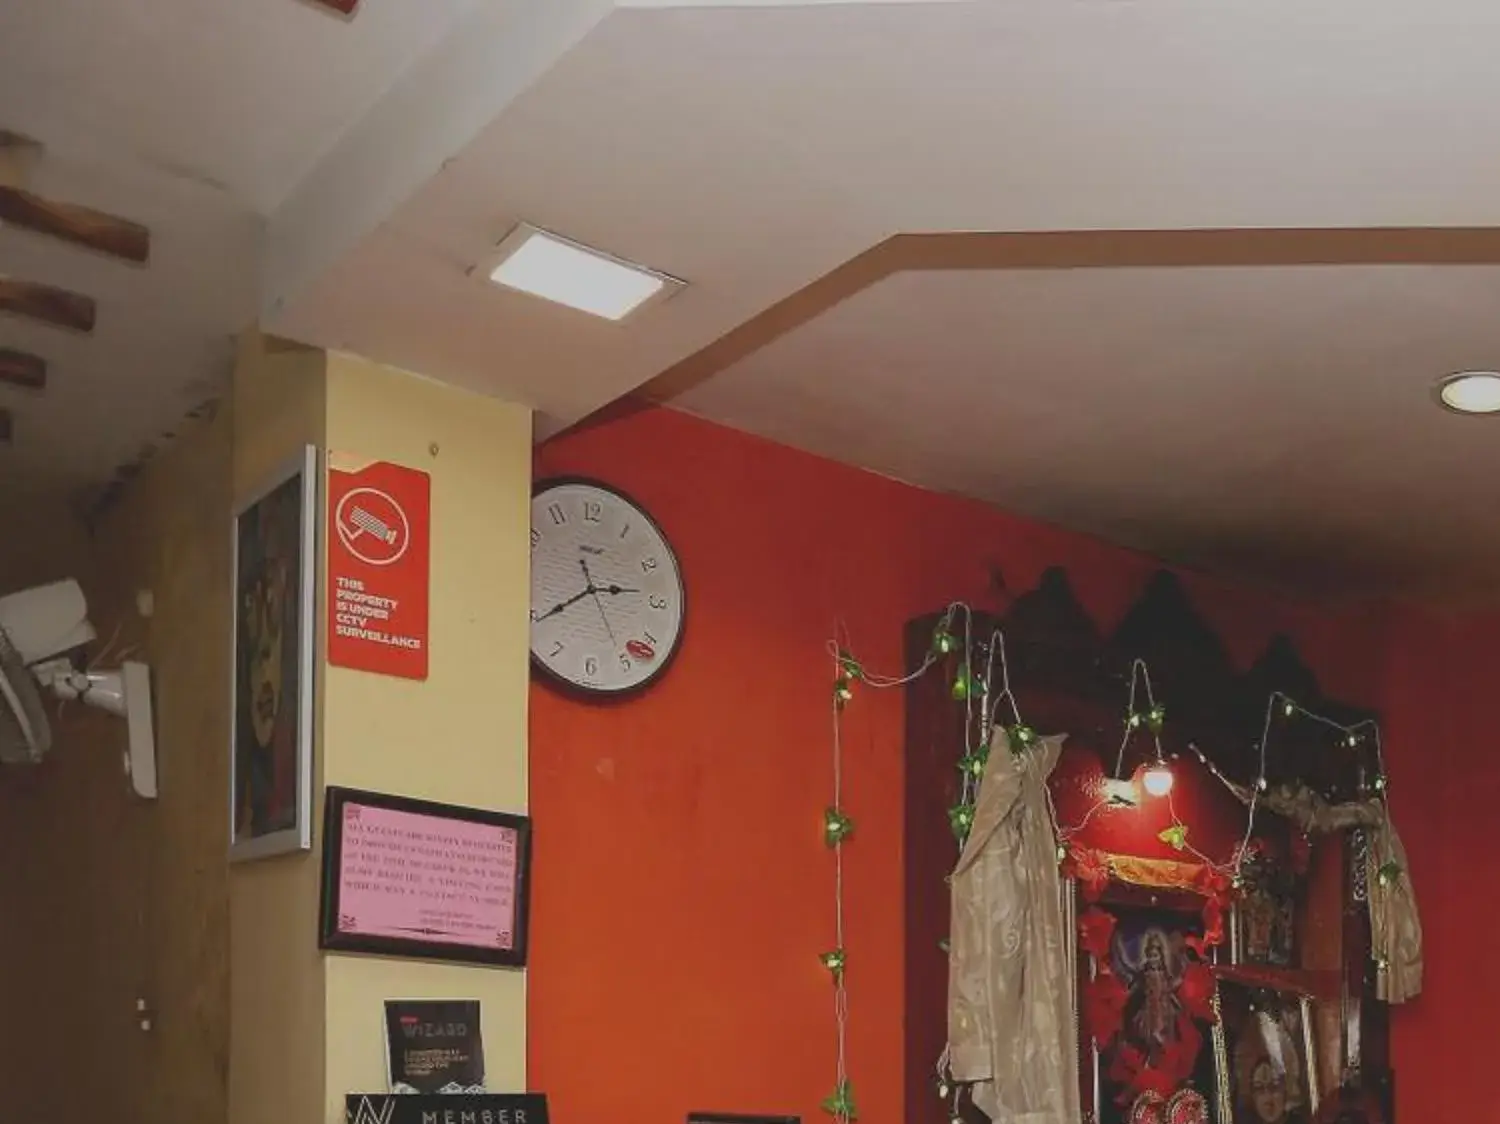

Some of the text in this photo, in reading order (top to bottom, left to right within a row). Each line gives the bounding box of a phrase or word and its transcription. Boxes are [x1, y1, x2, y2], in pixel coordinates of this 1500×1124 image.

[548, 502, 566, 525] 11
[584, 501, 602, 522] 12
[641, 556, 657, 574] 2
[335, 577, 365, 591] THIS
[335, 588, 399, 610] PROPERTY
[648, 595, 668, 610] 3
[336, 600, 389, 620] IS UNDER
[336, 612, 368, 628] CCTV
[336, 625, 421, 649] SURVEILLANCE
[549, 640, 564, 658] 7
[583, 656, 598, 675] 6
[618, 654, 632, 672] 5
